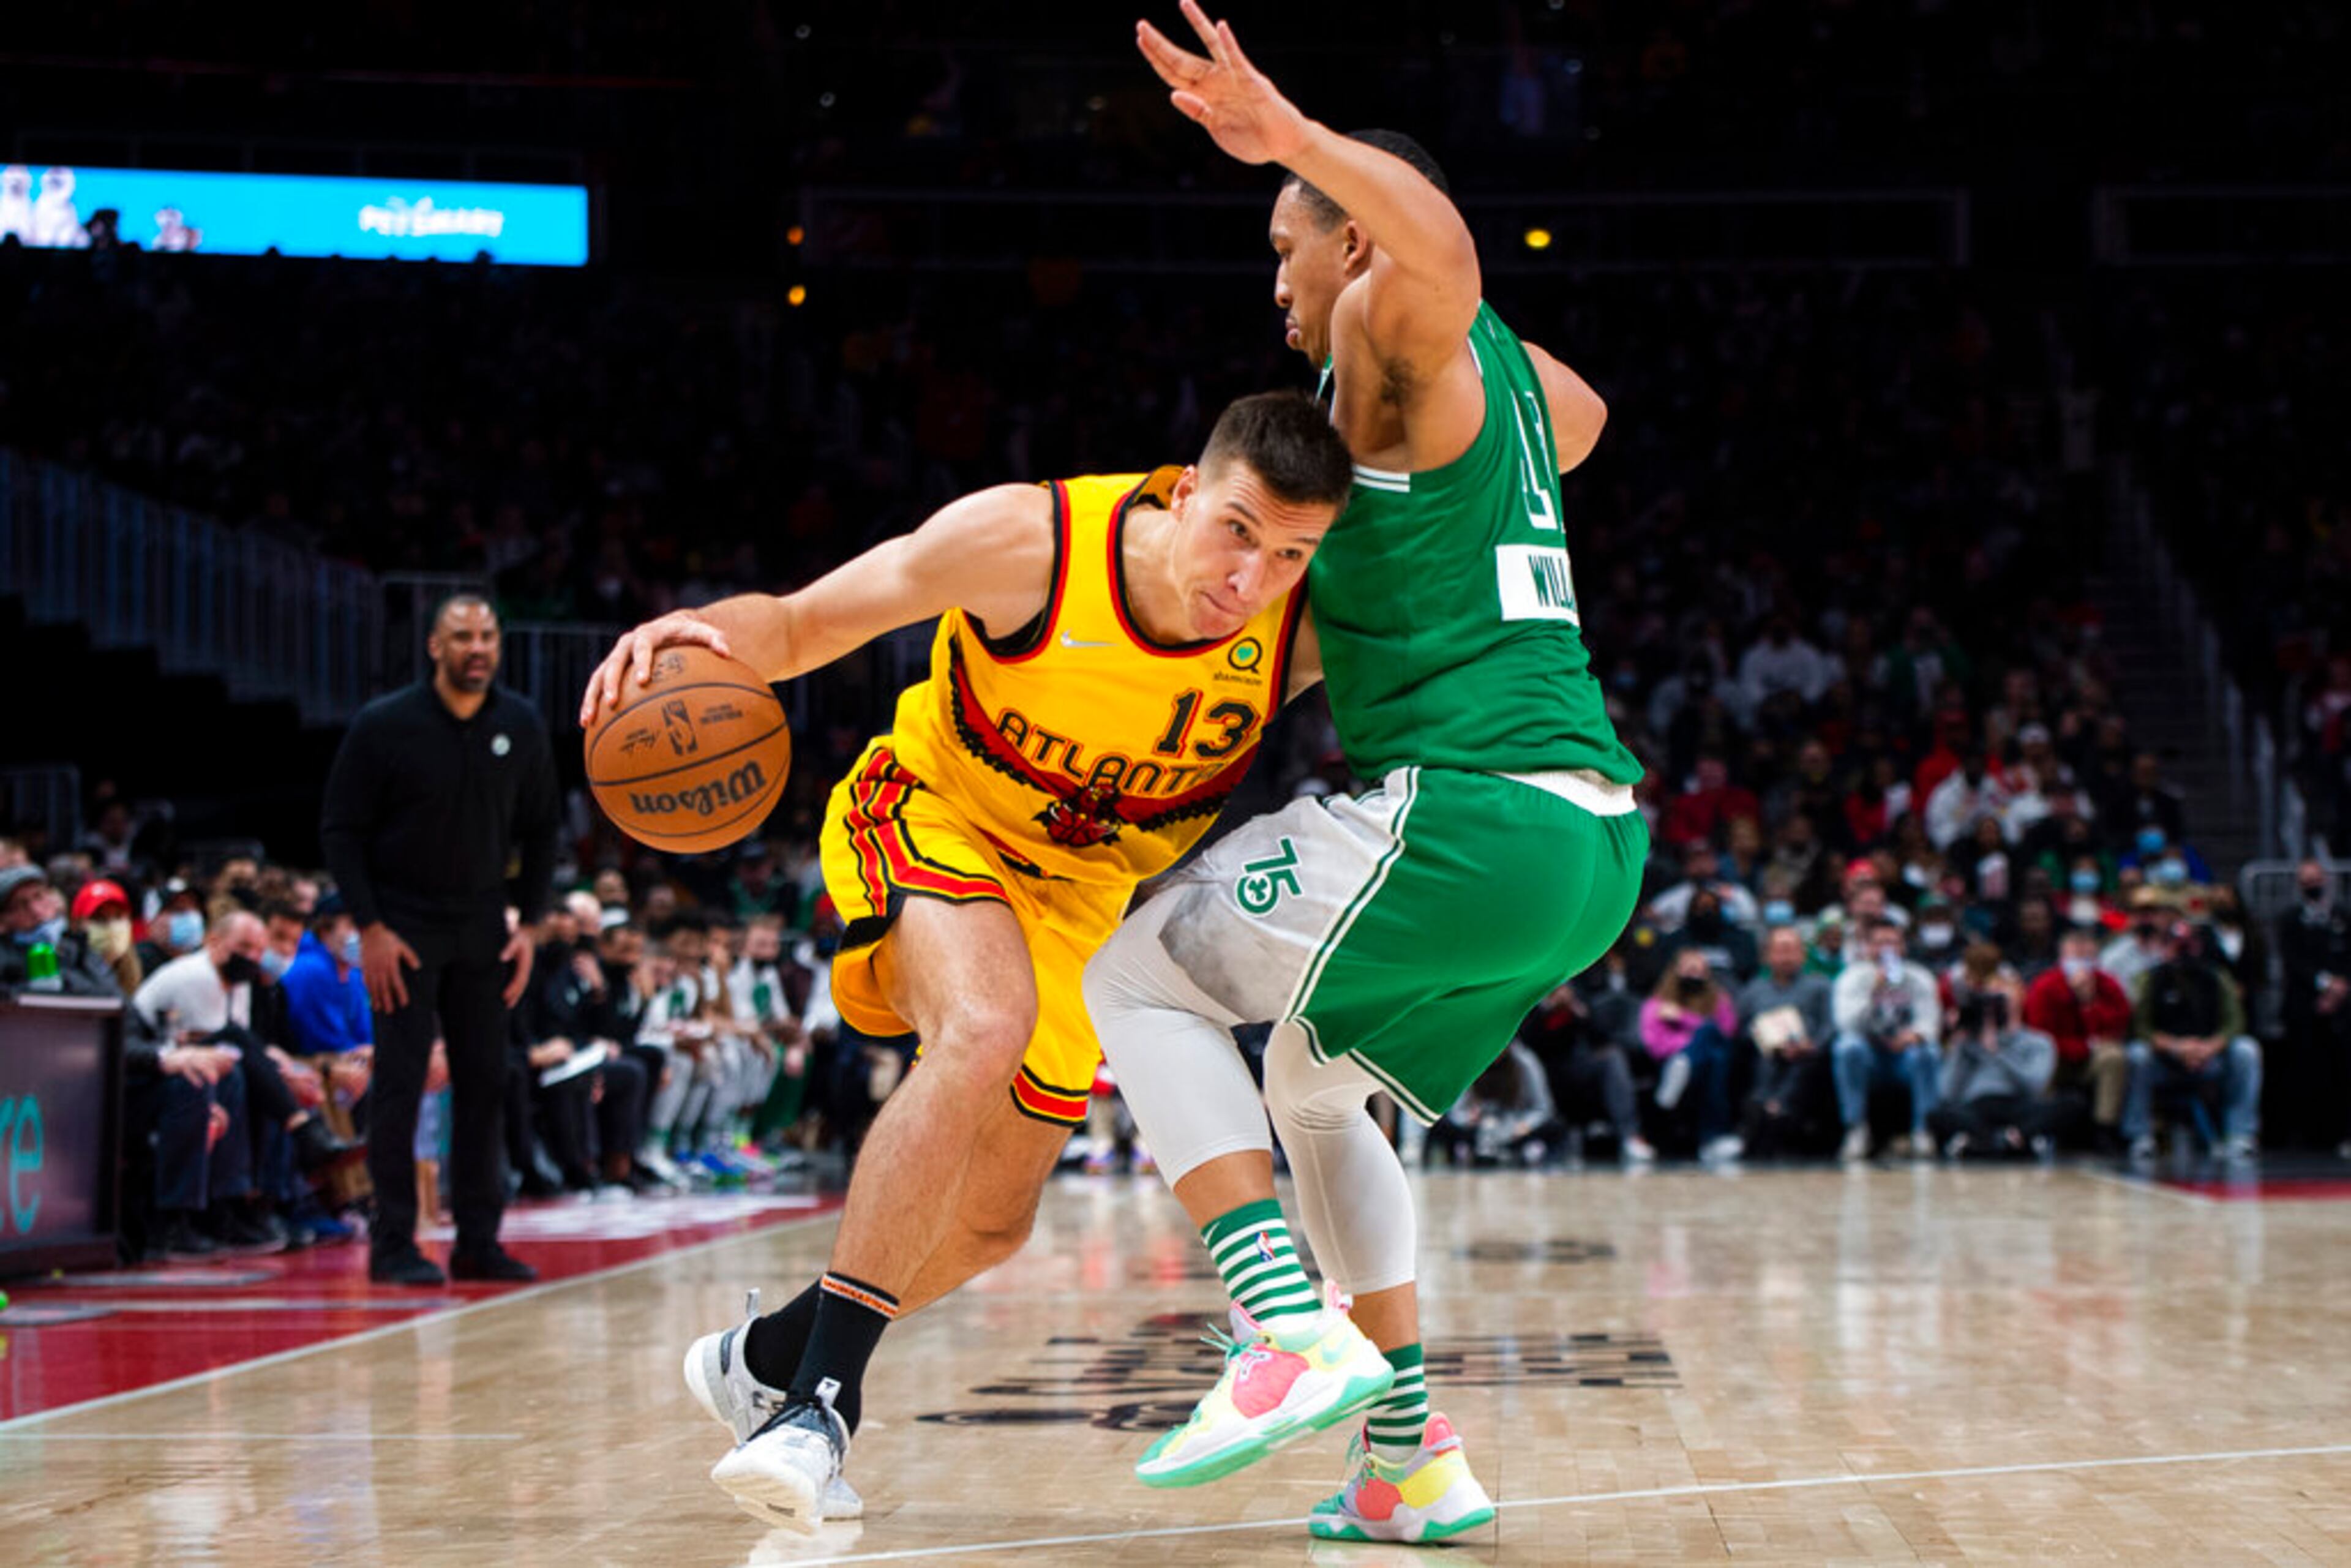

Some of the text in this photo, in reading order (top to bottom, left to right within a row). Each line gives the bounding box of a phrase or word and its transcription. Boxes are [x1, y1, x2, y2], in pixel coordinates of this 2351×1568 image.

[1152, 687, 1261, 761] 13
[630, 760, 767, 817] Wilson
[1236, 836, 1304, 915] 75
